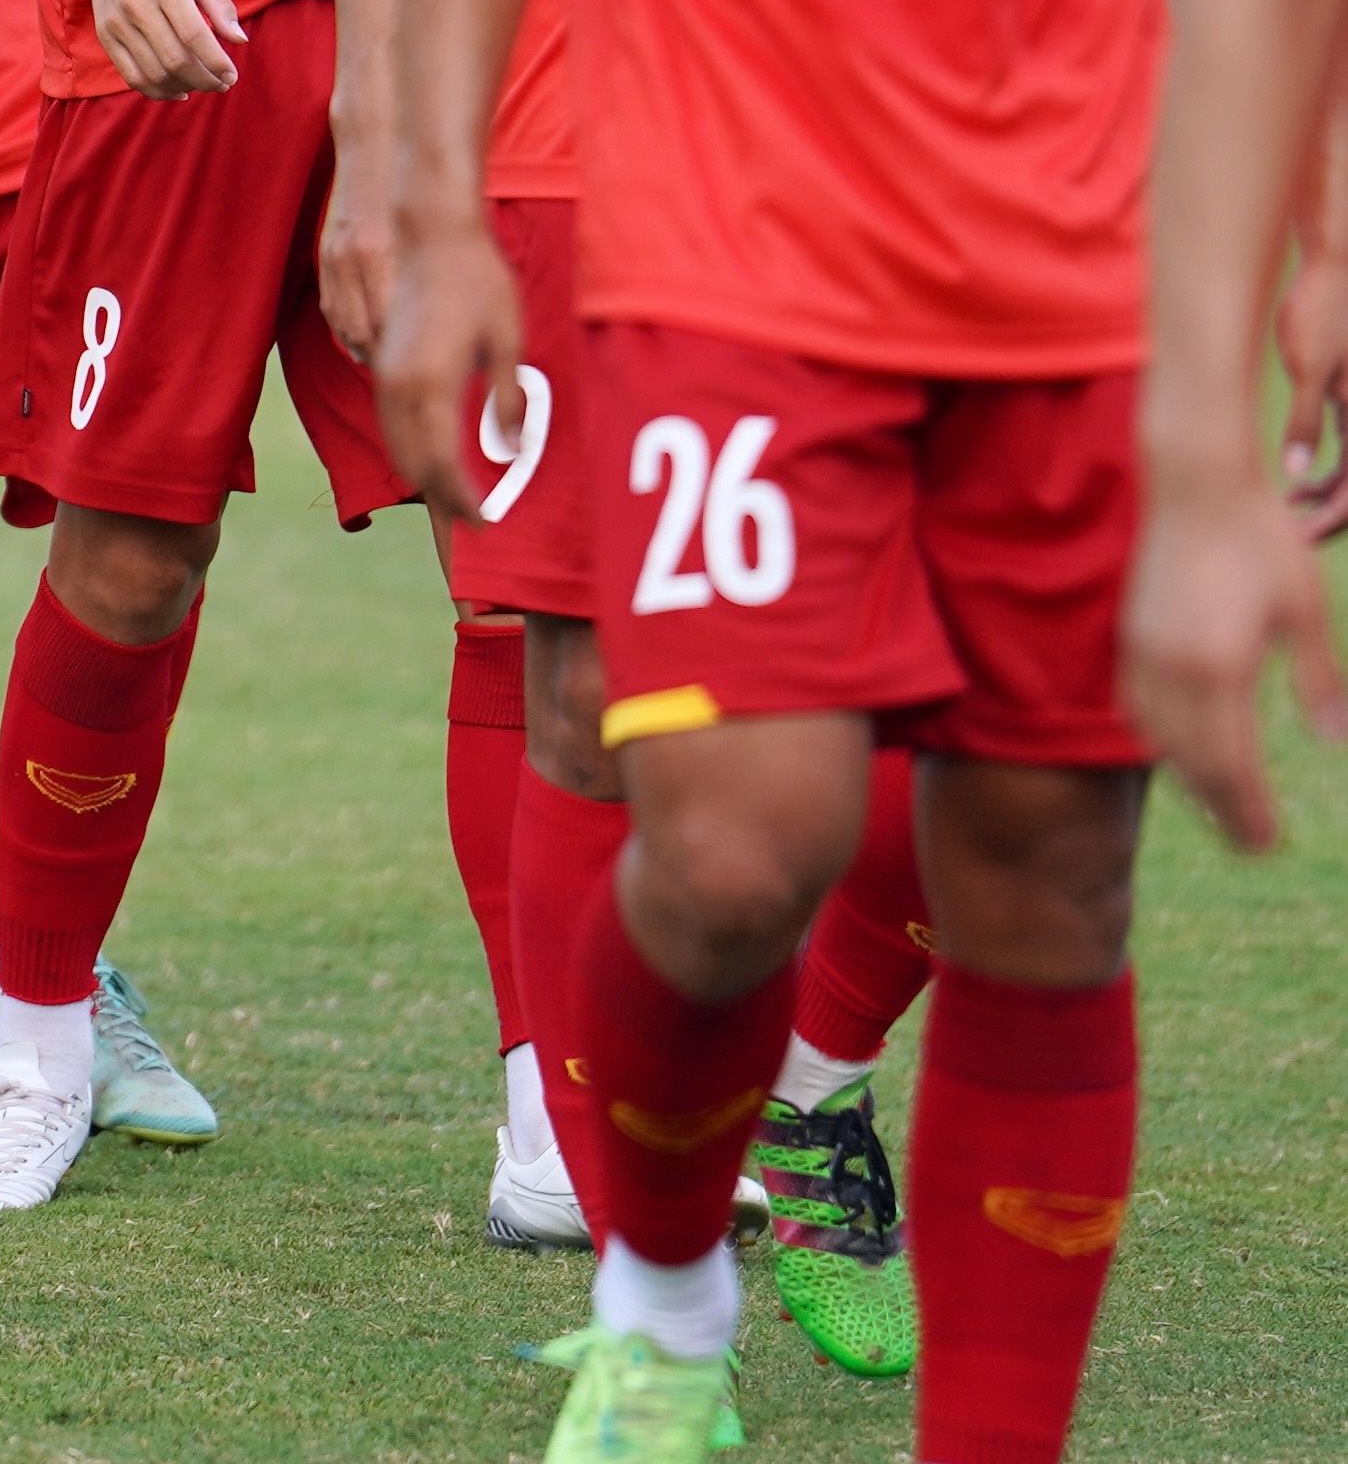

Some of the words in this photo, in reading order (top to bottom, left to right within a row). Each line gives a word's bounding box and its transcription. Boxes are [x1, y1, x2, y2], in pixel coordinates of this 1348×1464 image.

[70, 286, 121, 430] 8
[478, 364, 552, 524] 9
[627, 413, 797, 616] 26
